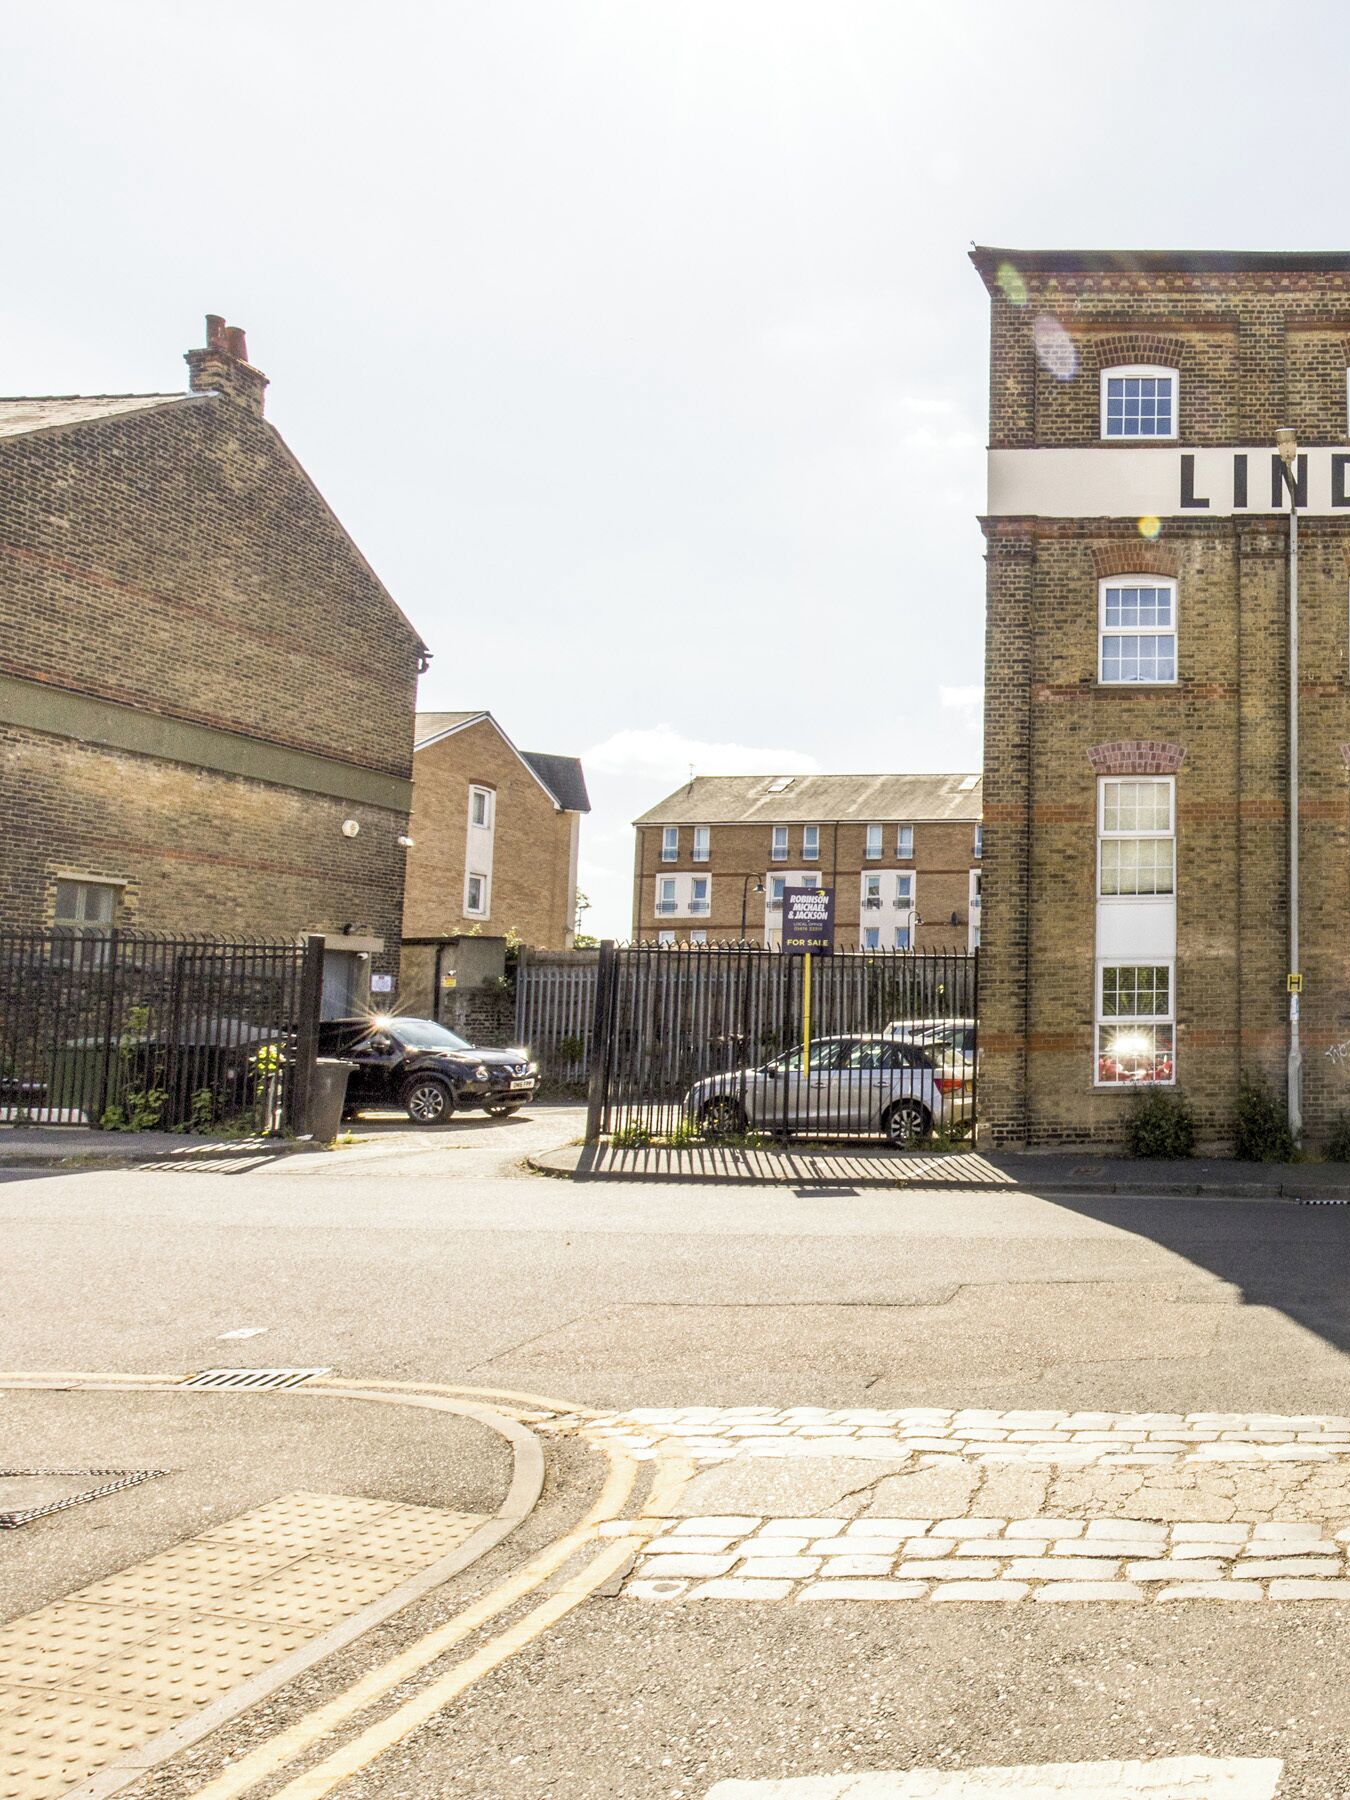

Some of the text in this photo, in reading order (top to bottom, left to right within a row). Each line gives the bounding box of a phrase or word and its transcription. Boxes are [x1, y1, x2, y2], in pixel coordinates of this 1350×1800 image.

[790, 895, 829, 904] ROBINSON
[793, 903, 825, 911] MICHAEL
[788, 911, 828, 920] & JACKSON
[1290, 975, 1300, 990] H
